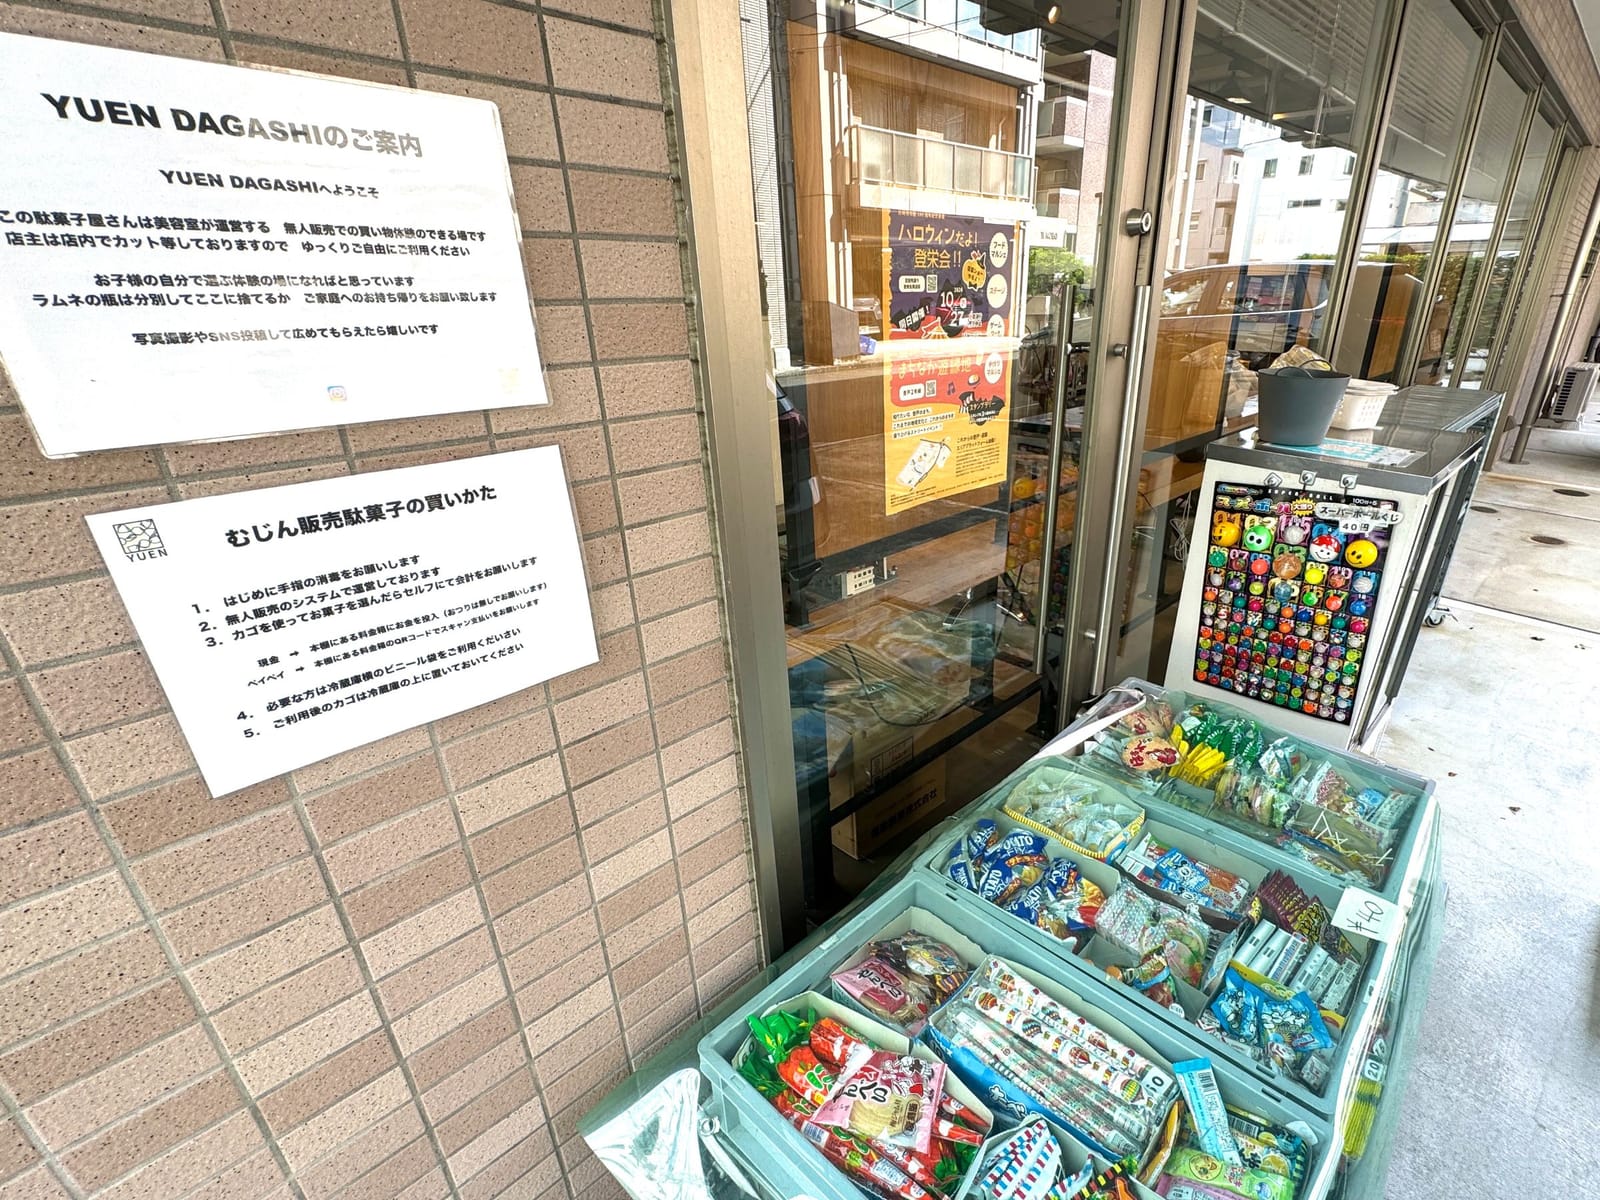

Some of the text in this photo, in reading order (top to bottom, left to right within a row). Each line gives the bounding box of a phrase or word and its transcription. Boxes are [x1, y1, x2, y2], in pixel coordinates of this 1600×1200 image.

[40, 92, 424, 158] YUEN DAGASHIのご案内
[159, 169, 380, 199] YUEN DAGASHIへようこそ
[0, 209, 487, 243] この駄菓子屋さんは美容室が運営する 無人販売での買い物体験のできる場です
[5, 231, 470, 257] 店主は店内でカット等しておりますので ゆっくりご自由にご利用ください
[93, 273, 415, 288] お子様の自分で選ぶ体験の場になればと思っています
[32, 291, 497, 308] ラムネの瓶は分別してここに捨てるか ご家庭へのお持ち帰りをお願い致します
[132, 323, 439, 346] 写真撮影やSNS投稿して広めてもらえたら嬉しいです
[225, 484, 497, 548] むじん販売駄菓子の買いかた
[1319, 506, 1399, 522] スーパーボールくじ
[126, 548, 169, 564] YUEN
[191, 555, 420, 614] 1. はじめに手指の消毒をお願いします
[198, 566, 441, 633] 2. 無人販売のシステムで運営しております
[205, 556, 537, 648] 3. カゴを使ってお菓子を選んだらセルフにて会計をお願いします
[257, 655, 280, 668] 現金
[243, 642, 525, 738] 5. ご利用後のカゴは冷蔵庫の上に置いておいてください
[236, 711, 254, 720] 4.
[1367, 1062, 1380, 1078] 20
